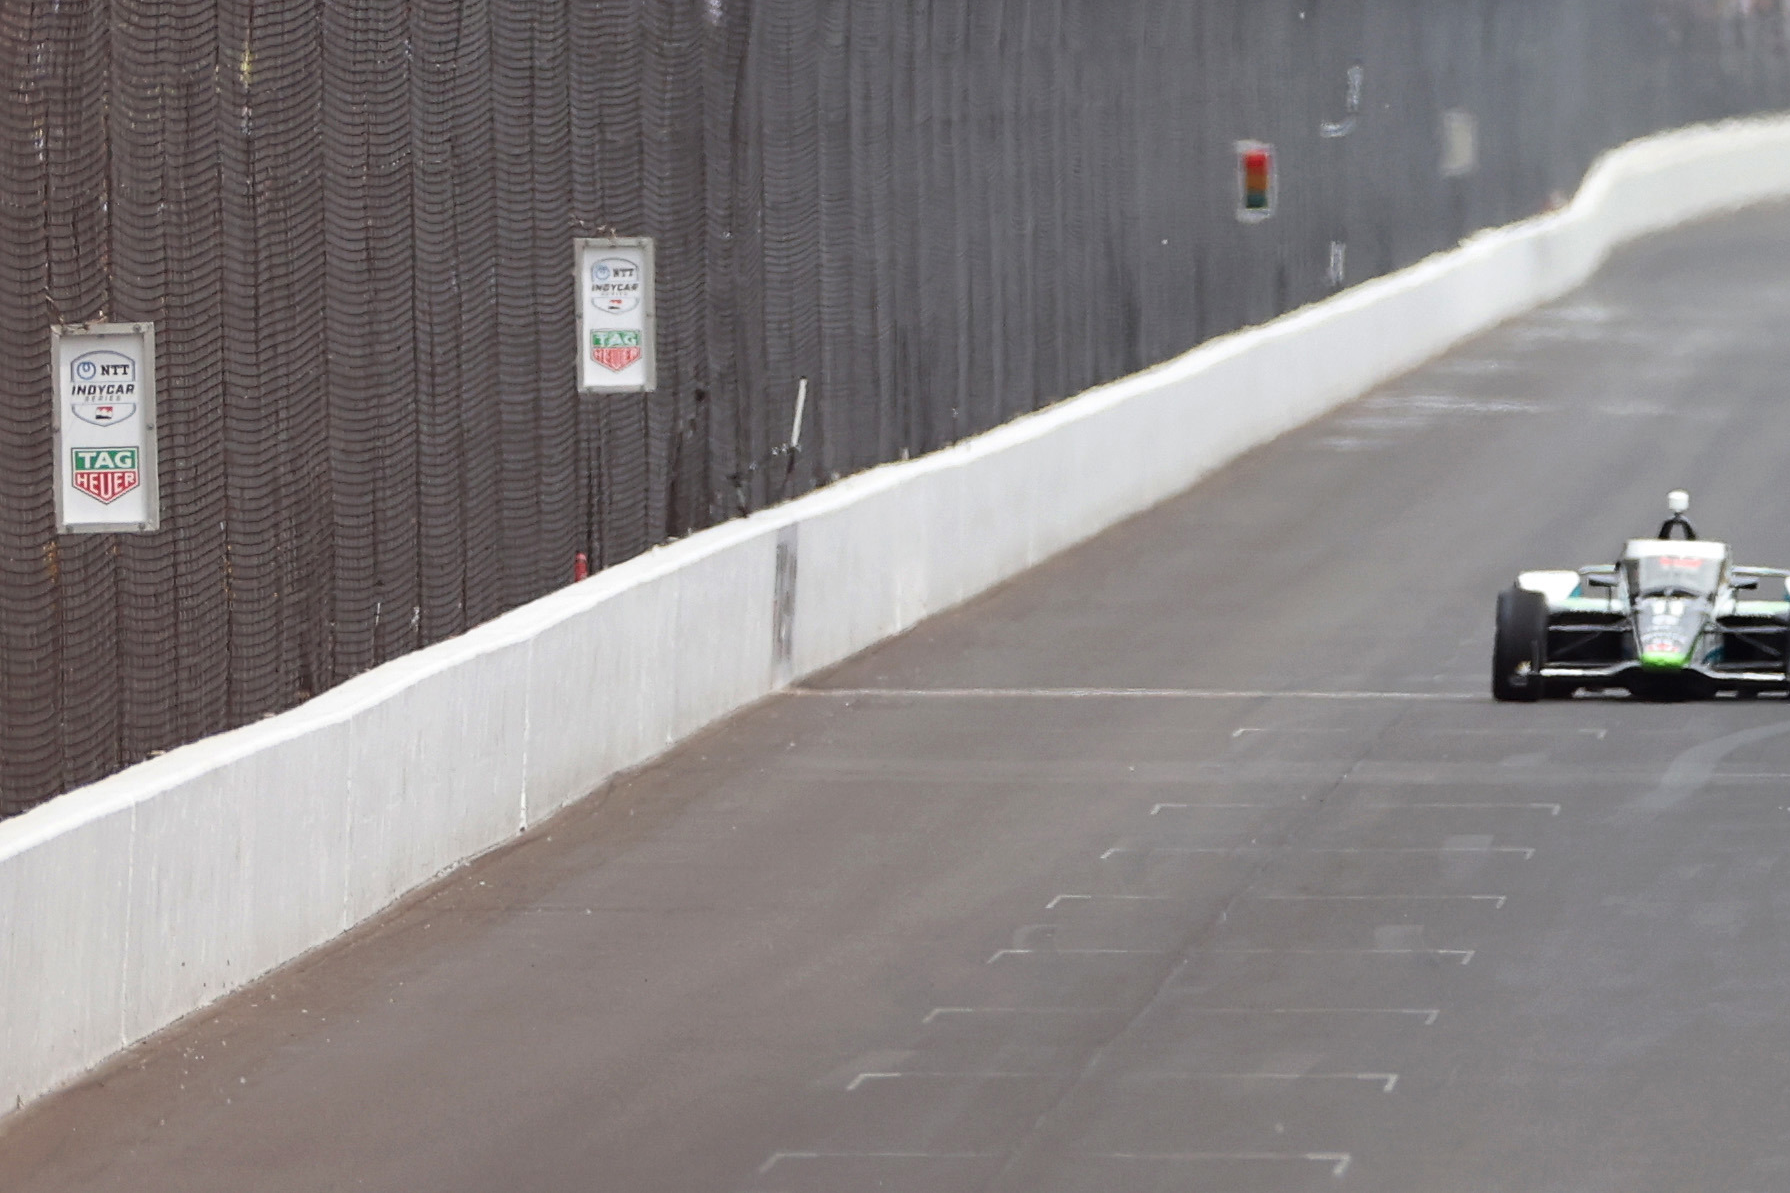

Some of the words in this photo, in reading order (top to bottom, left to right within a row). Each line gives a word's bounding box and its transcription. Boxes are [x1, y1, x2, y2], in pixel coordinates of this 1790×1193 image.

[591, 283, 639, 292] INDYCAR
[595, 332, 637, 347] TAG
[100, 364, 130, 376] NTT
[71, 384, 135, 396] INDYCAR
[78, 451, 133, 469] TAG
[76, 472, 136, 501] HEUER
